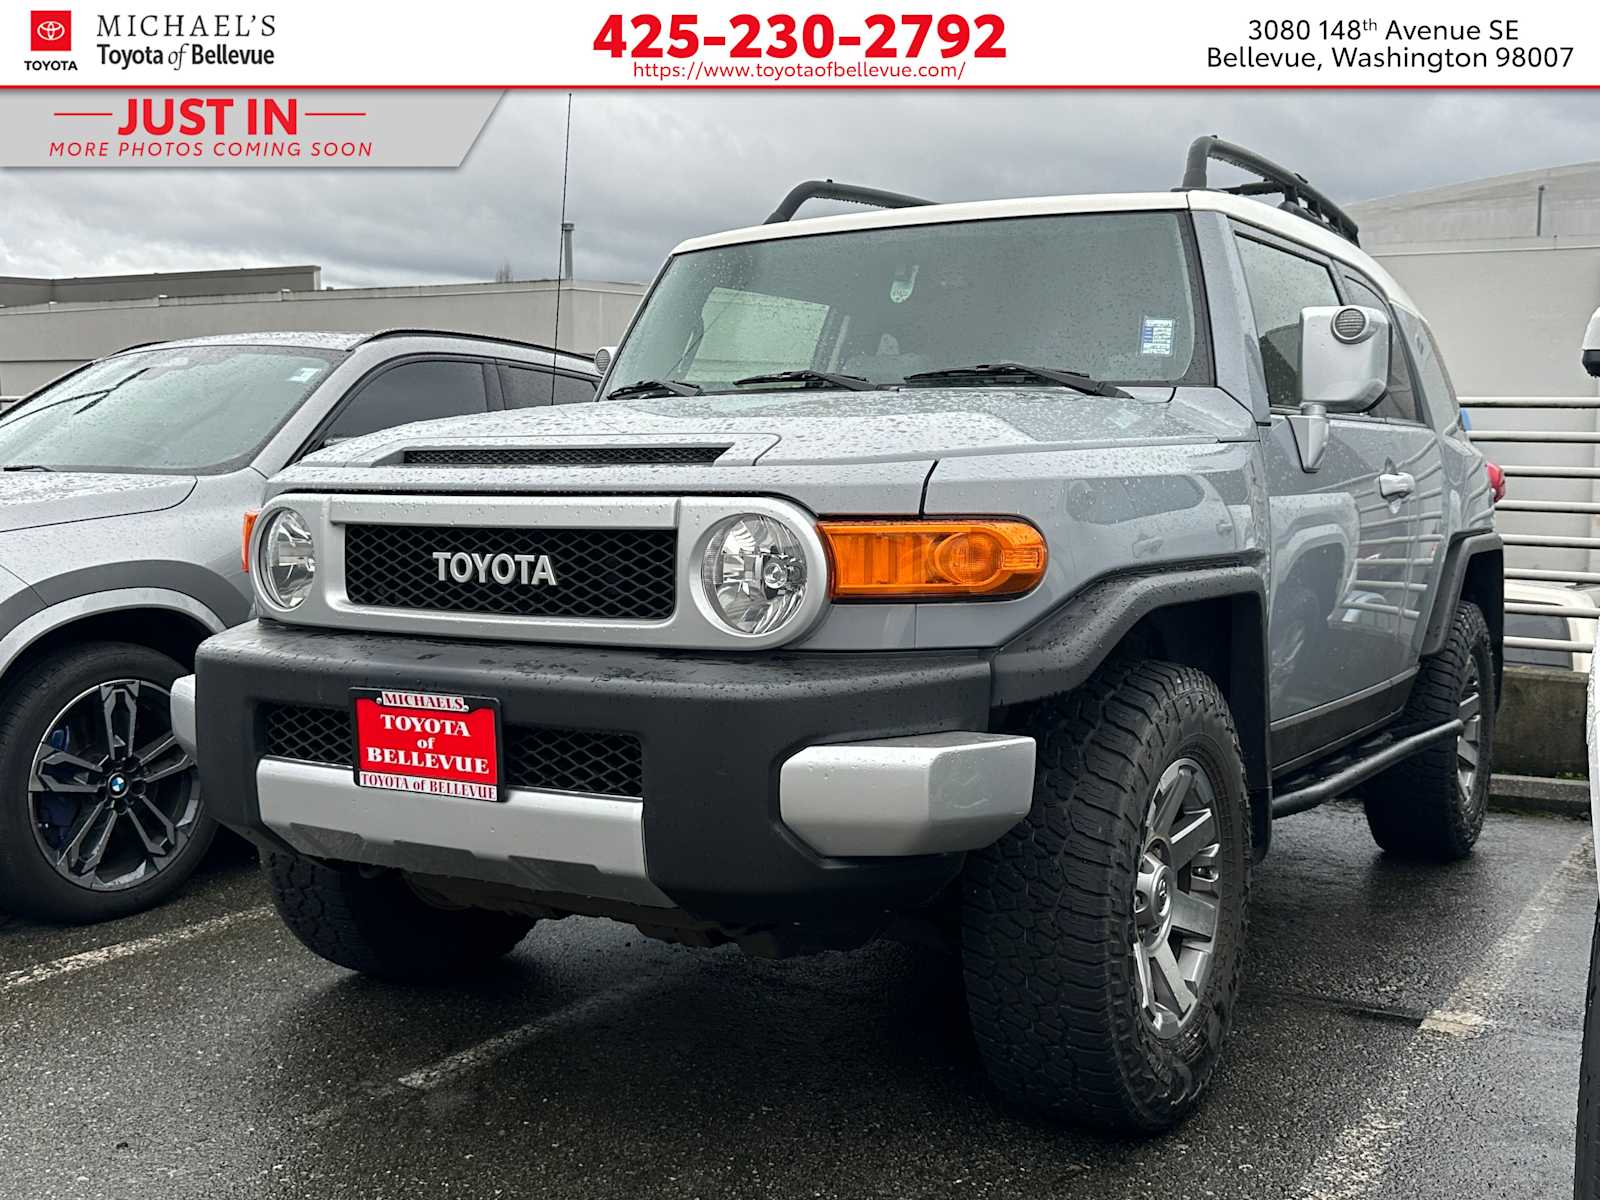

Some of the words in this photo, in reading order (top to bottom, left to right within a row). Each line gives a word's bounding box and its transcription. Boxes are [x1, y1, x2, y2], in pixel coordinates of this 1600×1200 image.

[432, 551, 557, 586] TOYOTA
[380, 714, 472, 736] TOYOTA
[416, 737, 436, 750] of
[367, 746, 490, 775] BELLEVUE
[361, 773, 409, 789] TOYOTA
[413, 779, 426, 791] of
[430, 782, 496, 799] BELLEVUE
